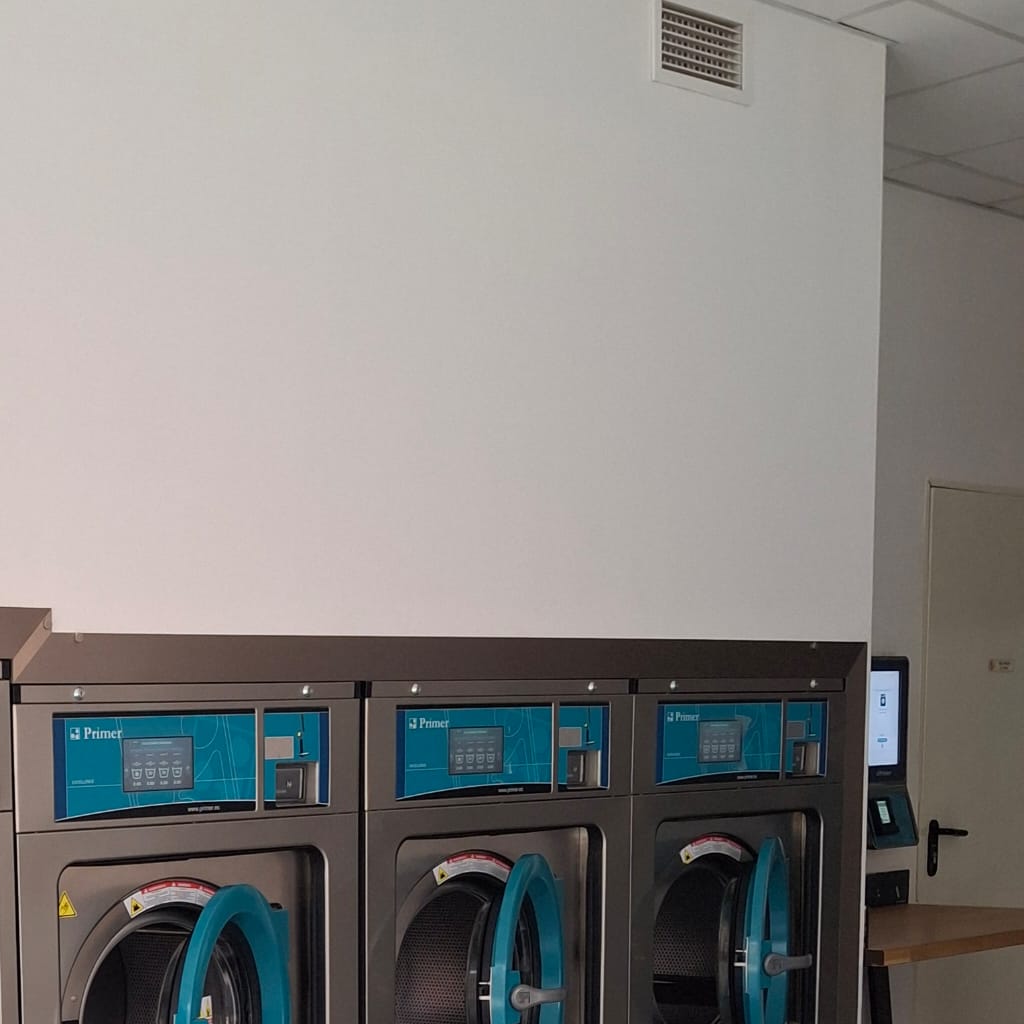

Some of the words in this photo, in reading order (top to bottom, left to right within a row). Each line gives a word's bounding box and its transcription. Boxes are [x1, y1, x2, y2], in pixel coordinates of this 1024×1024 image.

[675, 711, 700, 722] Primer
[419, 717, 450, 729] Primer
[83, 726, 122, 740] Primer
